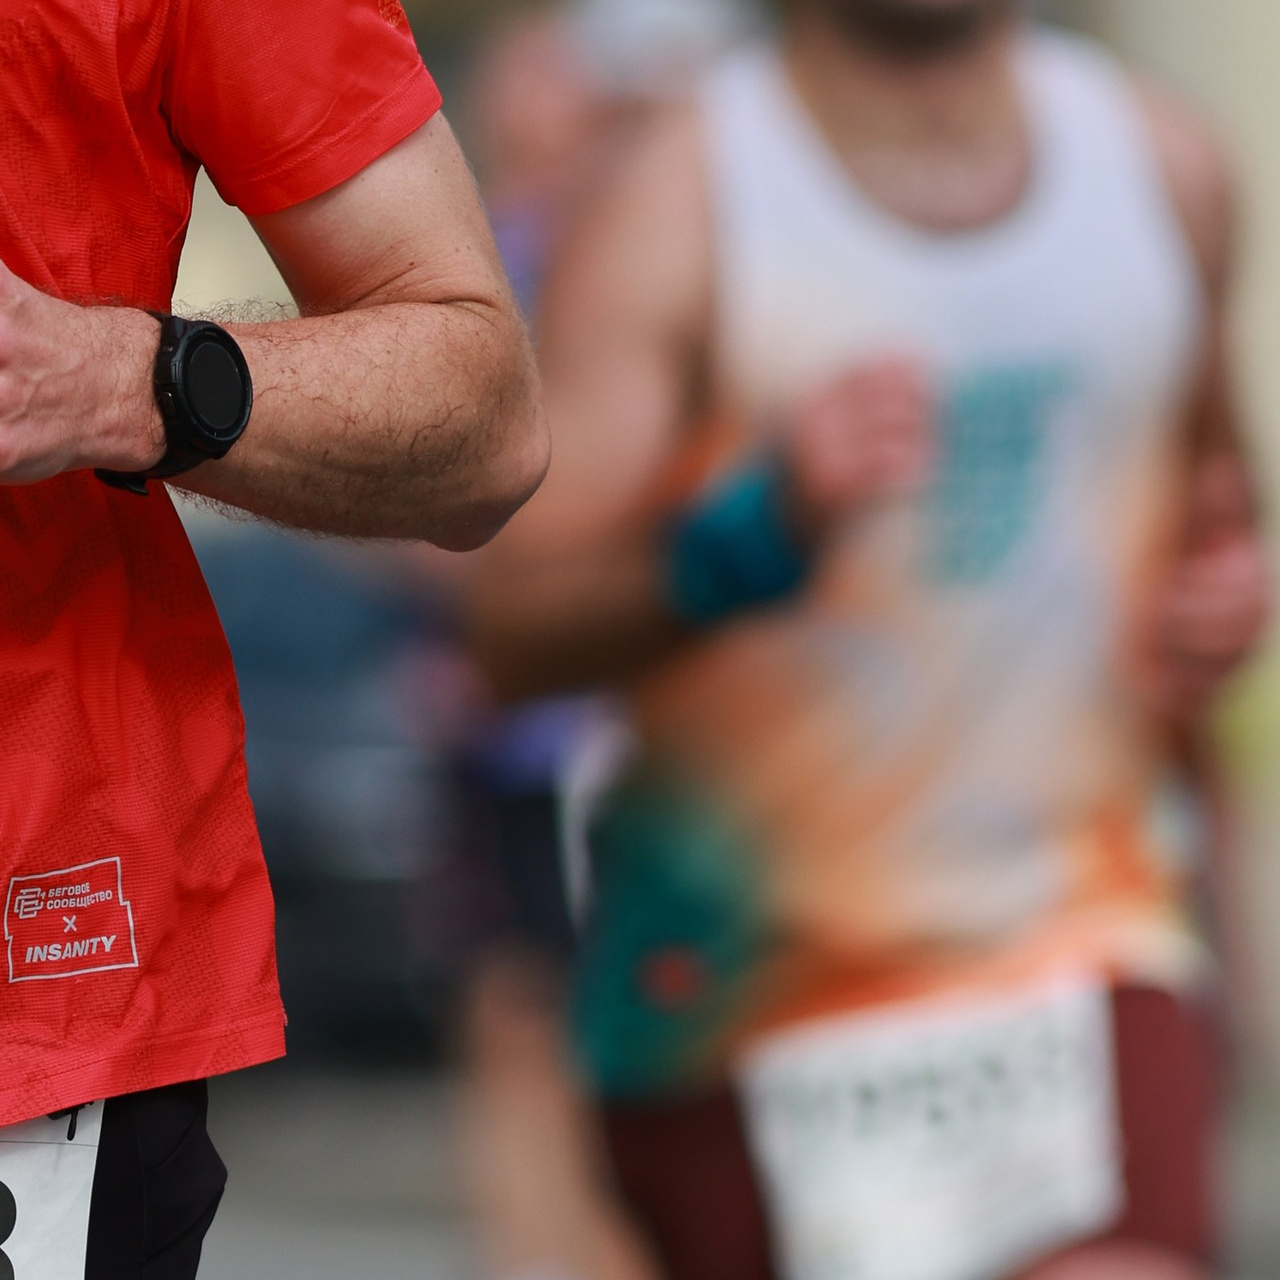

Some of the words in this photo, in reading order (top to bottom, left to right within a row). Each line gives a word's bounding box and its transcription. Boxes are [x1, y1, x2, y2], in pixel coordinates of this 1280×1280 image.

[46, 890, 113, 910] СООБЩЕСТВО
[48, 882, 91, 898] БЕГОВОЕ
[25, 934, 116, 963] INSANITY
